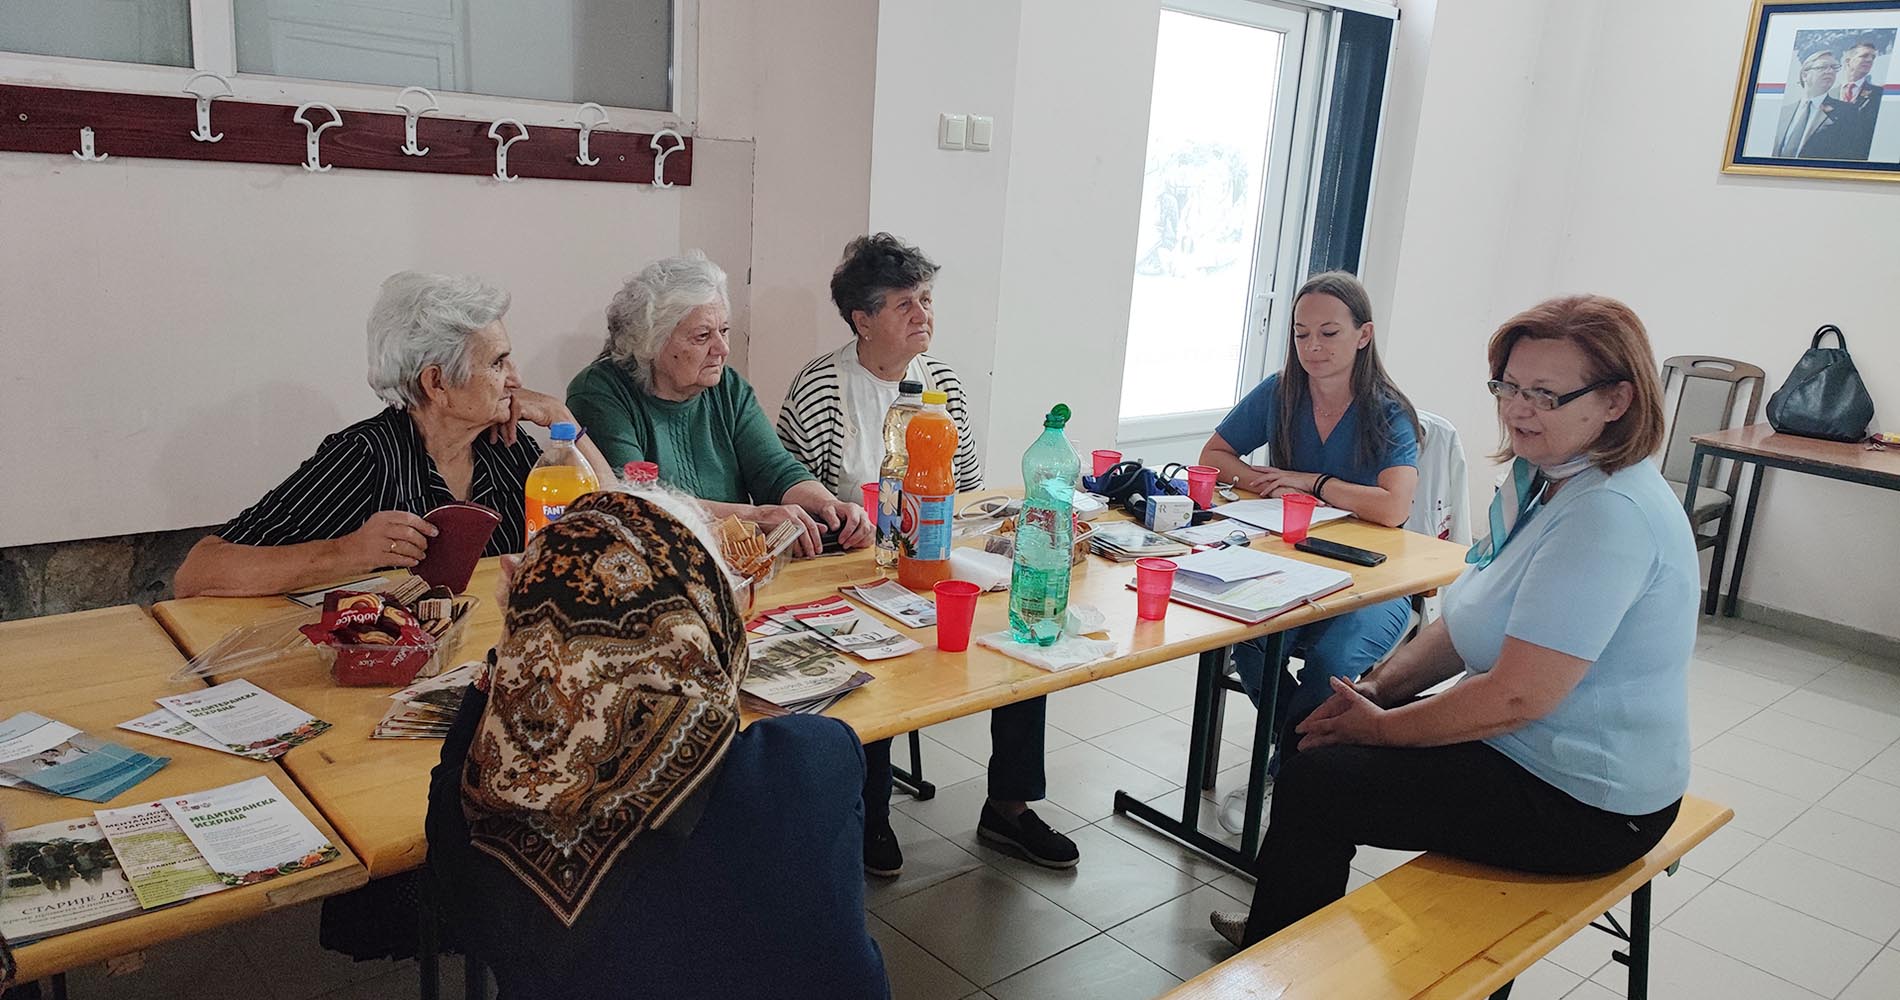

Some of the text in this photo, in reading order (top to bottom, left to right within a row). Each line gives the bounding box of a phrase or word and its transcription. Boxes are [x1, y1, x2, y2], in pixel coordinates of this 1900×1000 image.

[543, 505, 566, 515] FANT
[186, 692, 258, 714] МЕДИТЕРАНСКА
[191, 704, 236, 717] ИСХРАНА
[189, 798, 277, 823] МЕДИТЕРАНСКА
[194, 813, 247, 828] ИСХРАНА
[22, 894, 96, 915] СТАРИЈЕ
[100, 886, 135, 900] ДОБ
